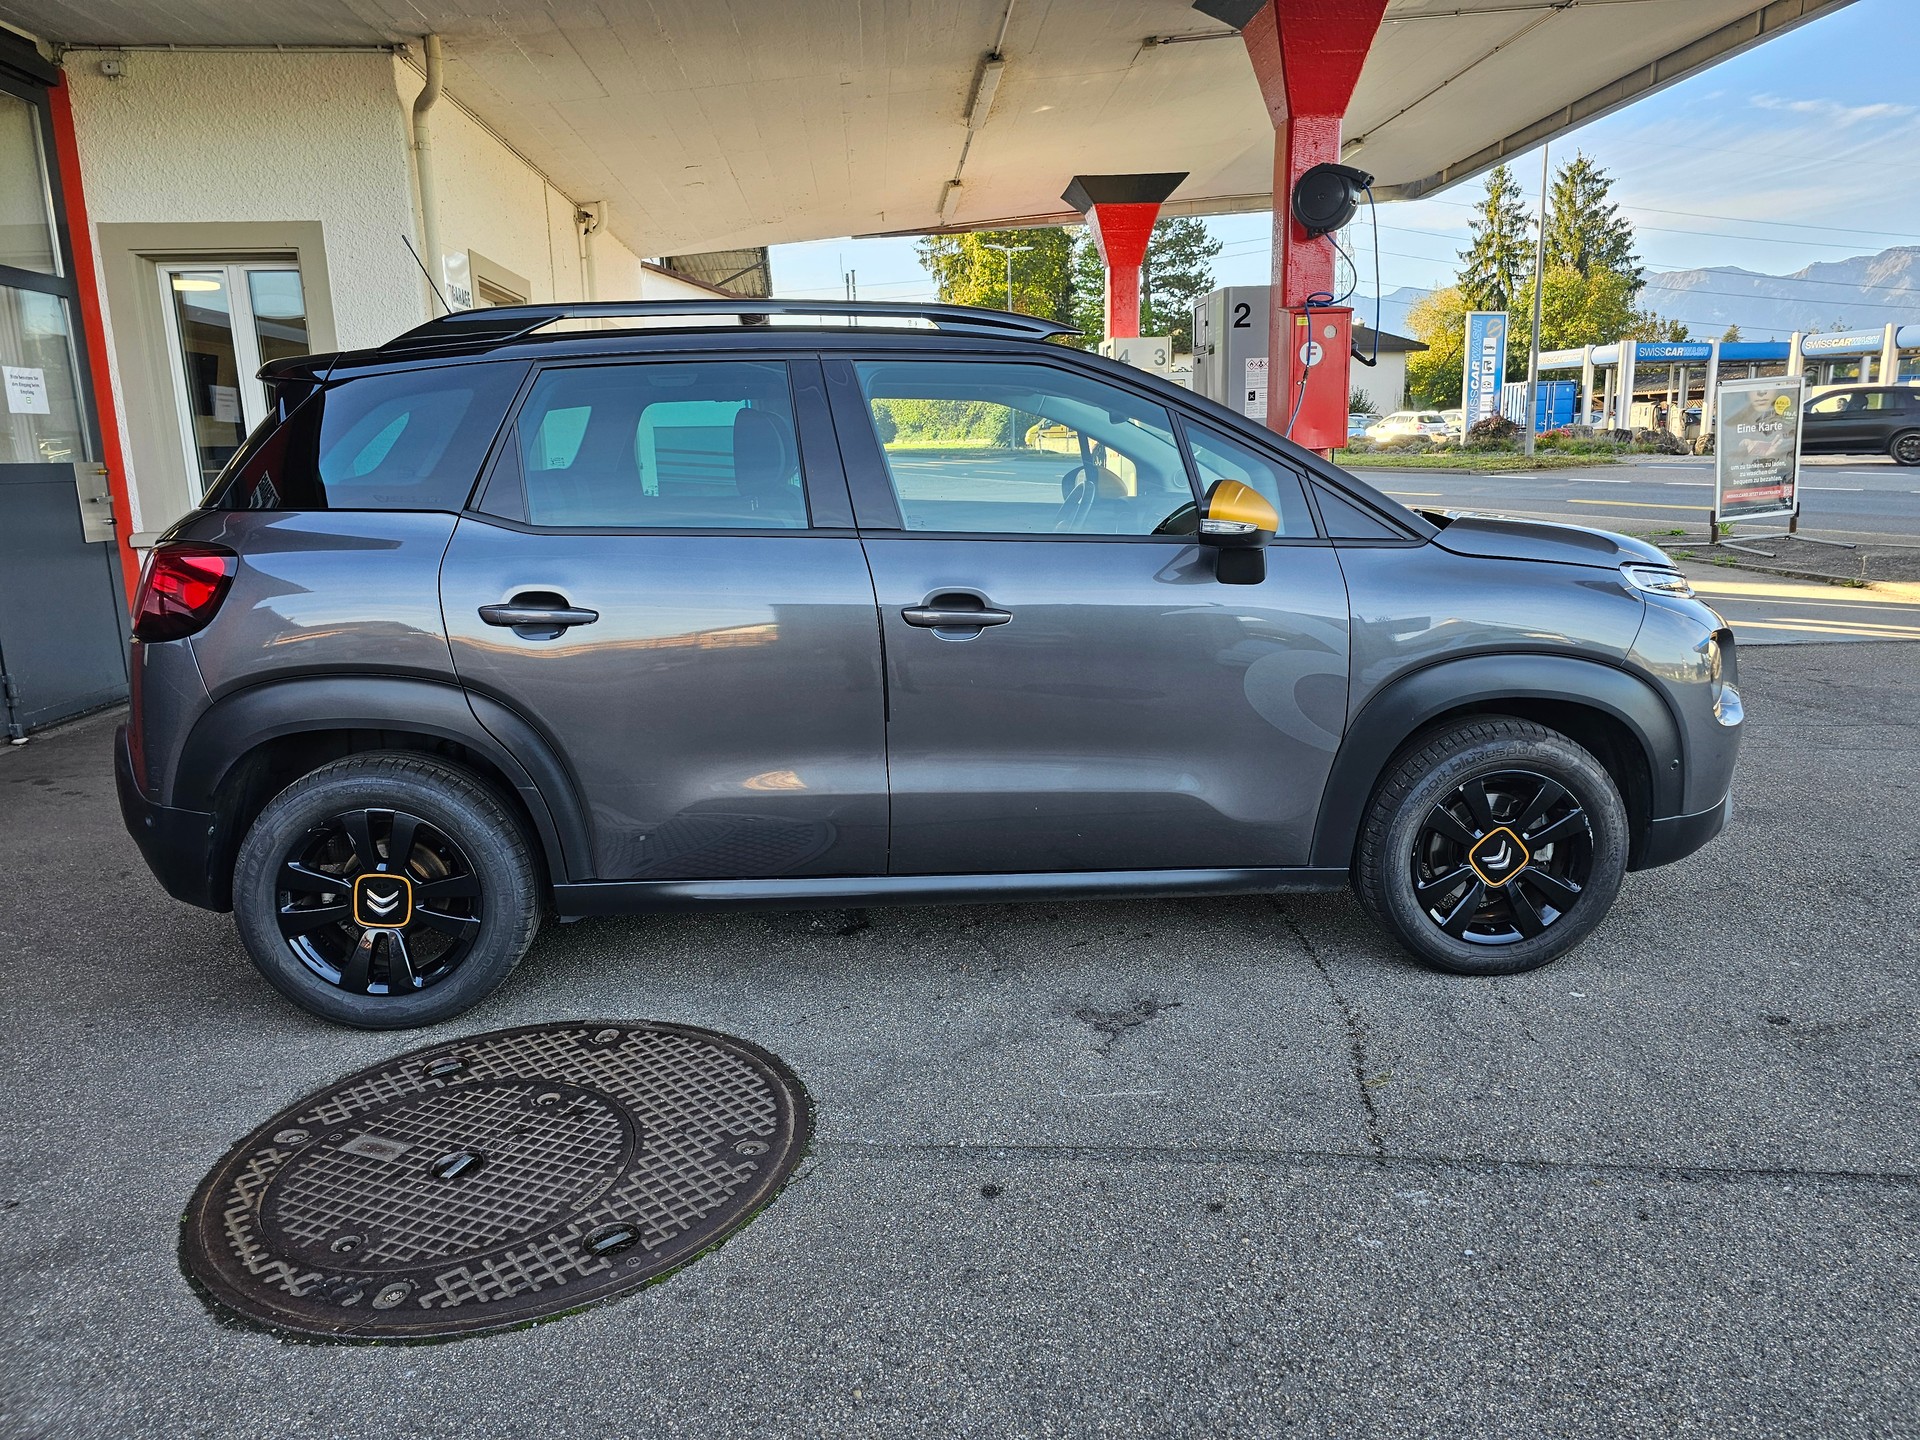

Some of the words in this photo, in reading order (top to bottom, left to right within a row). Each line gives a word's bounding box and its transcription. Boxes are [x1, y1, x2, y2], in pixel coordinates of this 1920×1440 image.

[1233, 302, 1251, 329] 2
[1118, 348, 1130, 364] 4
[1154, 348, 1166, 366] 3
[1306, 346, 1317, 361] F
[1737, 423, 1756, 433] Eine
[1758, 422, 1783, 432] Karte
